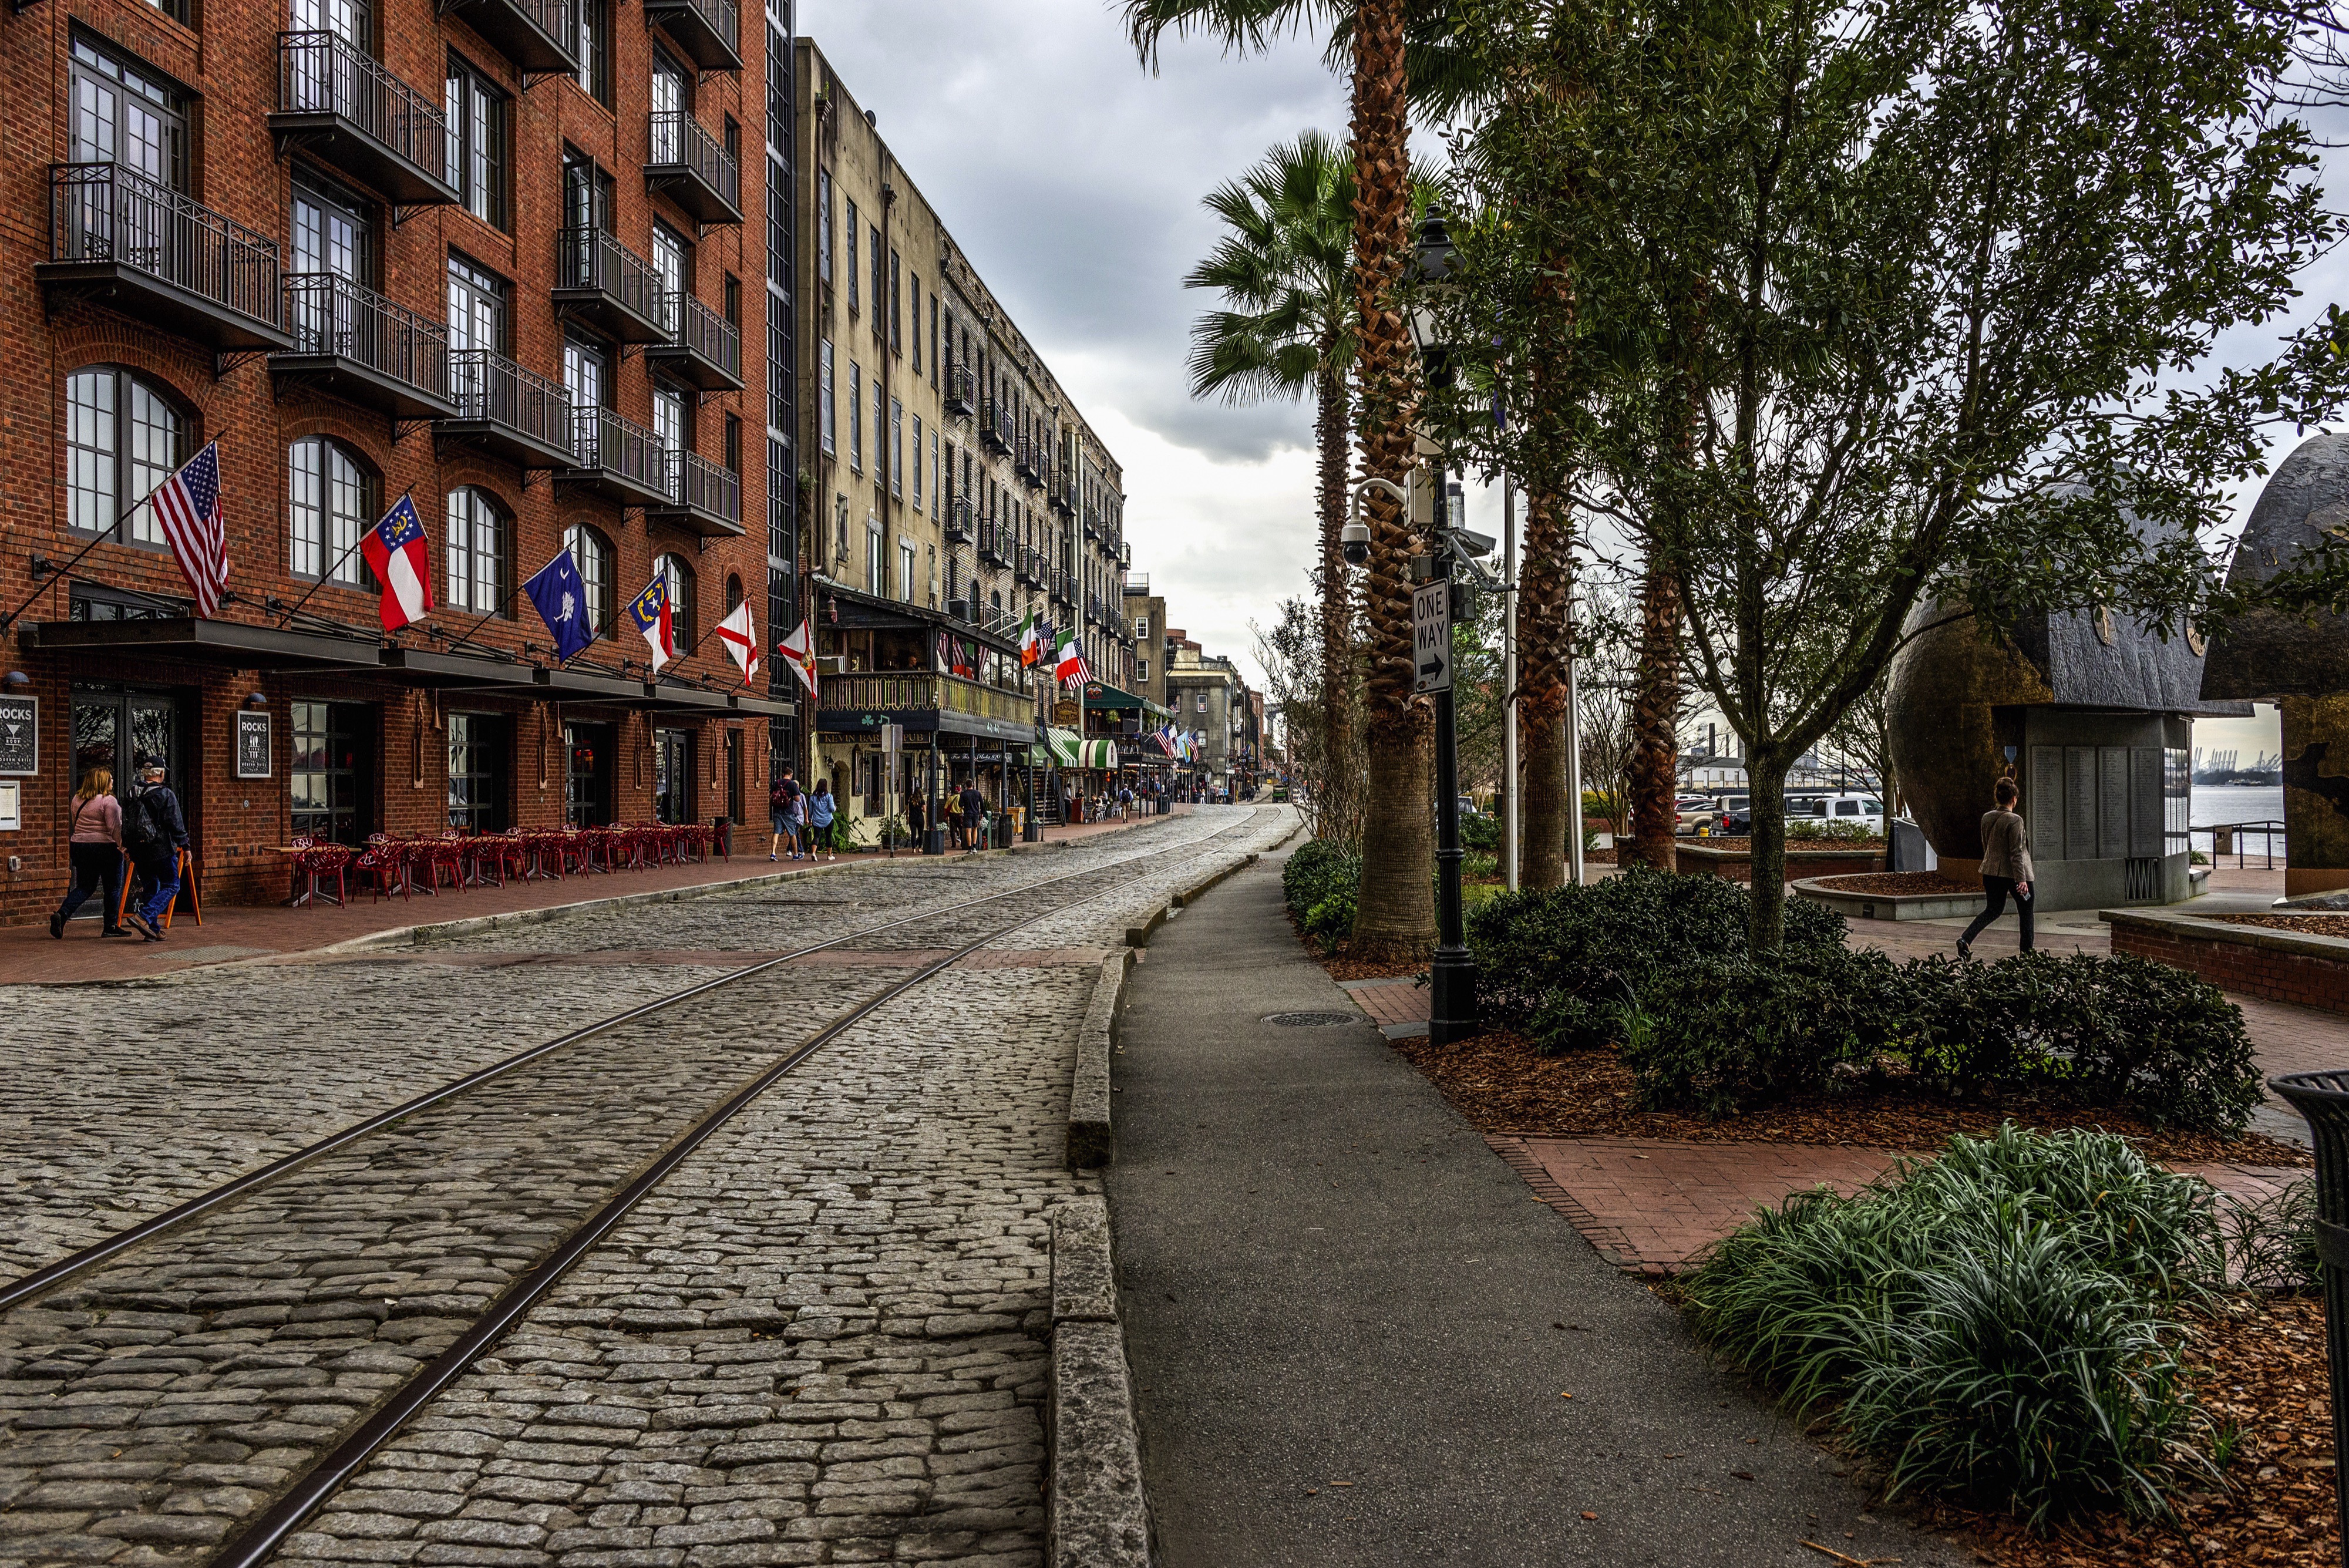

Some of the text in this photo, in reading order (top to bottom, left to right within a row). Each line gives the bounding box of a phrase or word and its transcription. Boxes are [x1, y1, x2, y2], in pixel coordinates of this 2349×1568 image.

[1418, 590, 1443, 621] ONE
[1418, 620, 1445, 650] WAY
[241, 722, 267, 732] ROCKS
[859, 734, 881, 742] BAR
[904, 733, 923, 742] PUB
